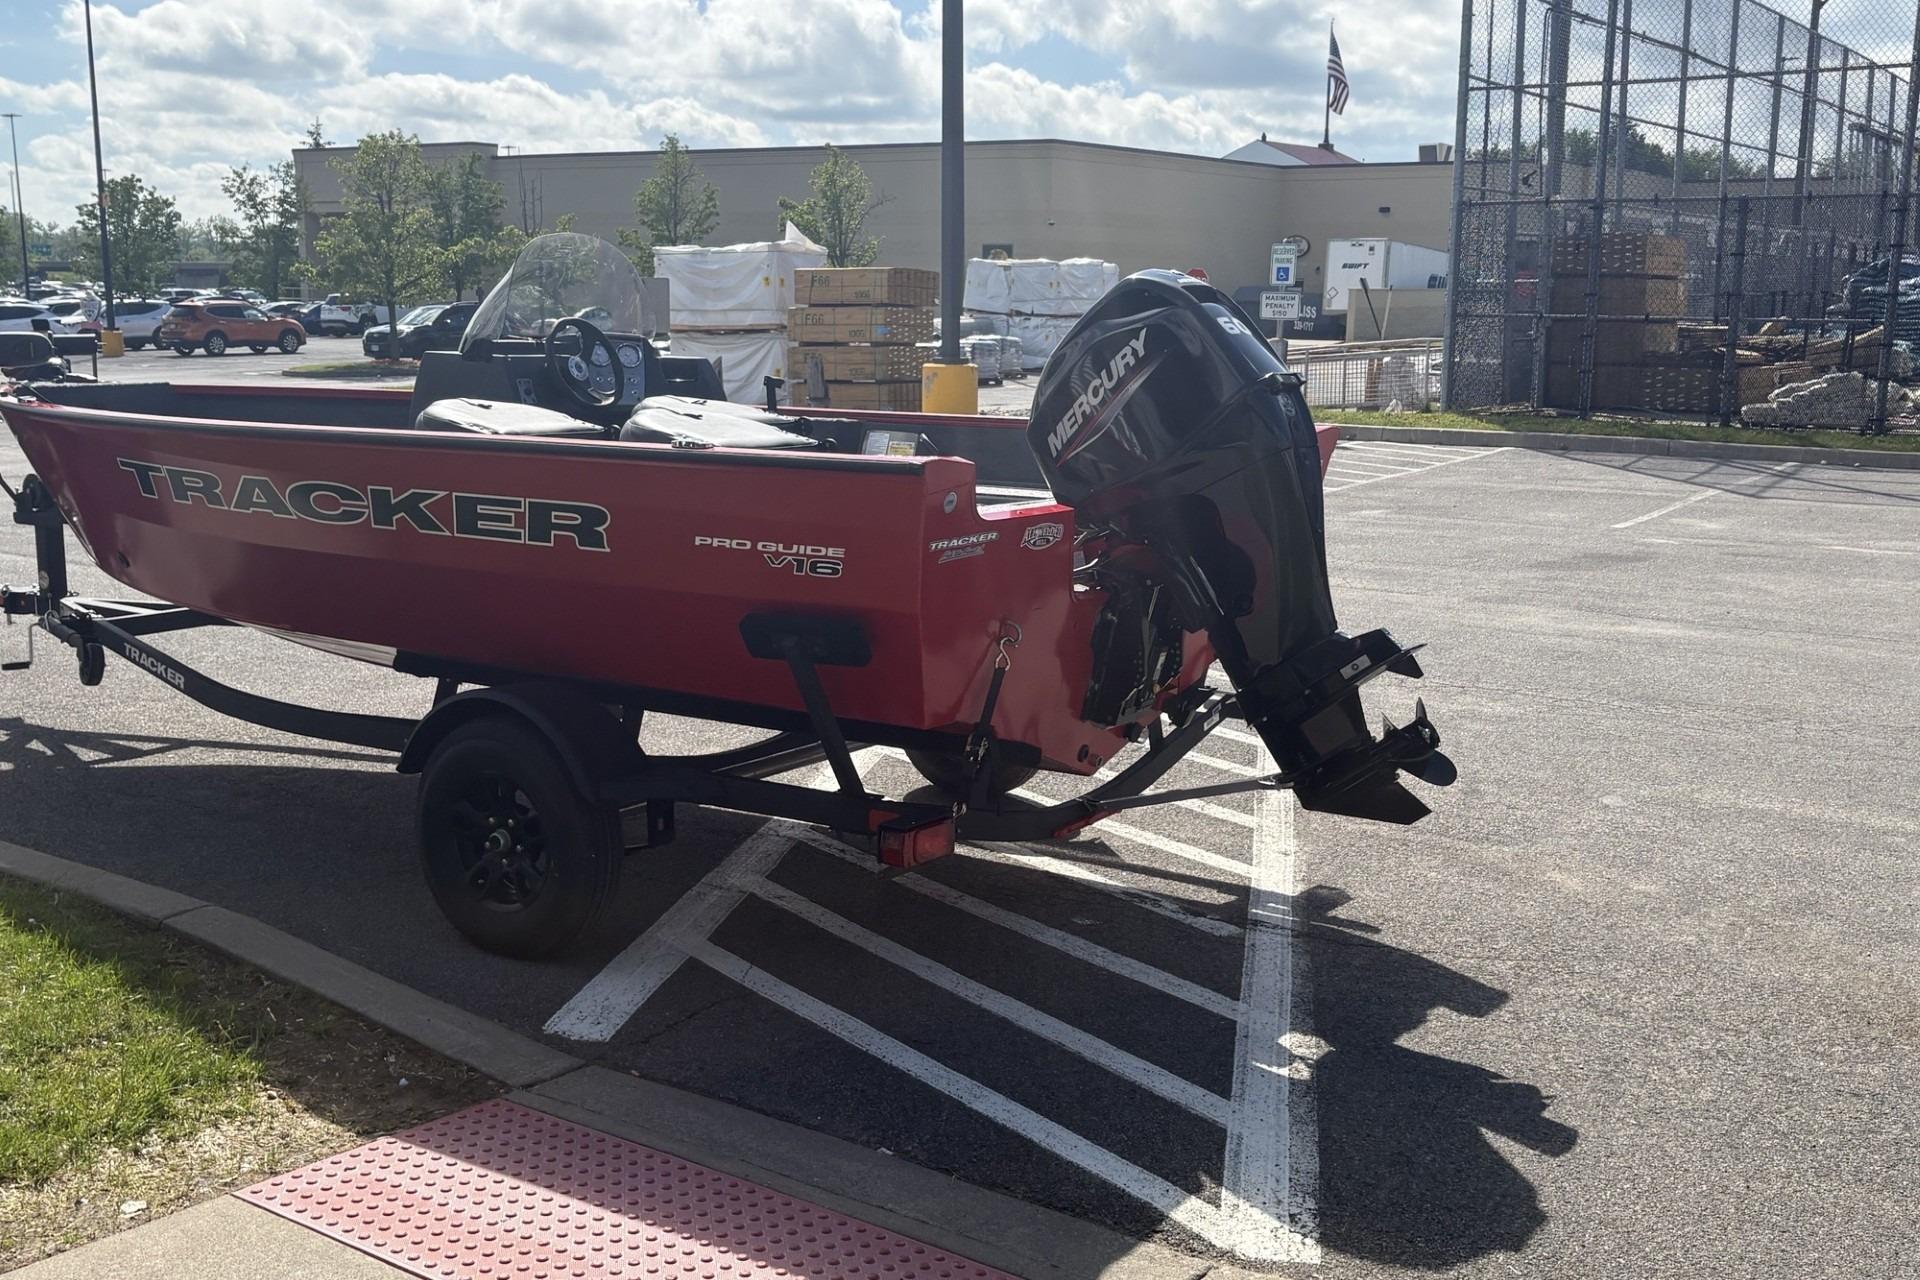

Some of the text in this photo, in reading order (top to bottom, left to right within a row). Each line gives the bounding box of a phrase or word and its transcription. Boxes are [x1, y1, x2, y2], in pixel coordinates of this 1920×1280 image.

[1047, 327, 1147, 459] MERCURY
[117, 457, 610, 552] TRACKER
[694, 535, 846, 558] PRO GUIDE
[929, 532, 998, 552] TRACKER
[763, 553, 843, 578] V16
[124, 642, 185, 690] TRACKER
